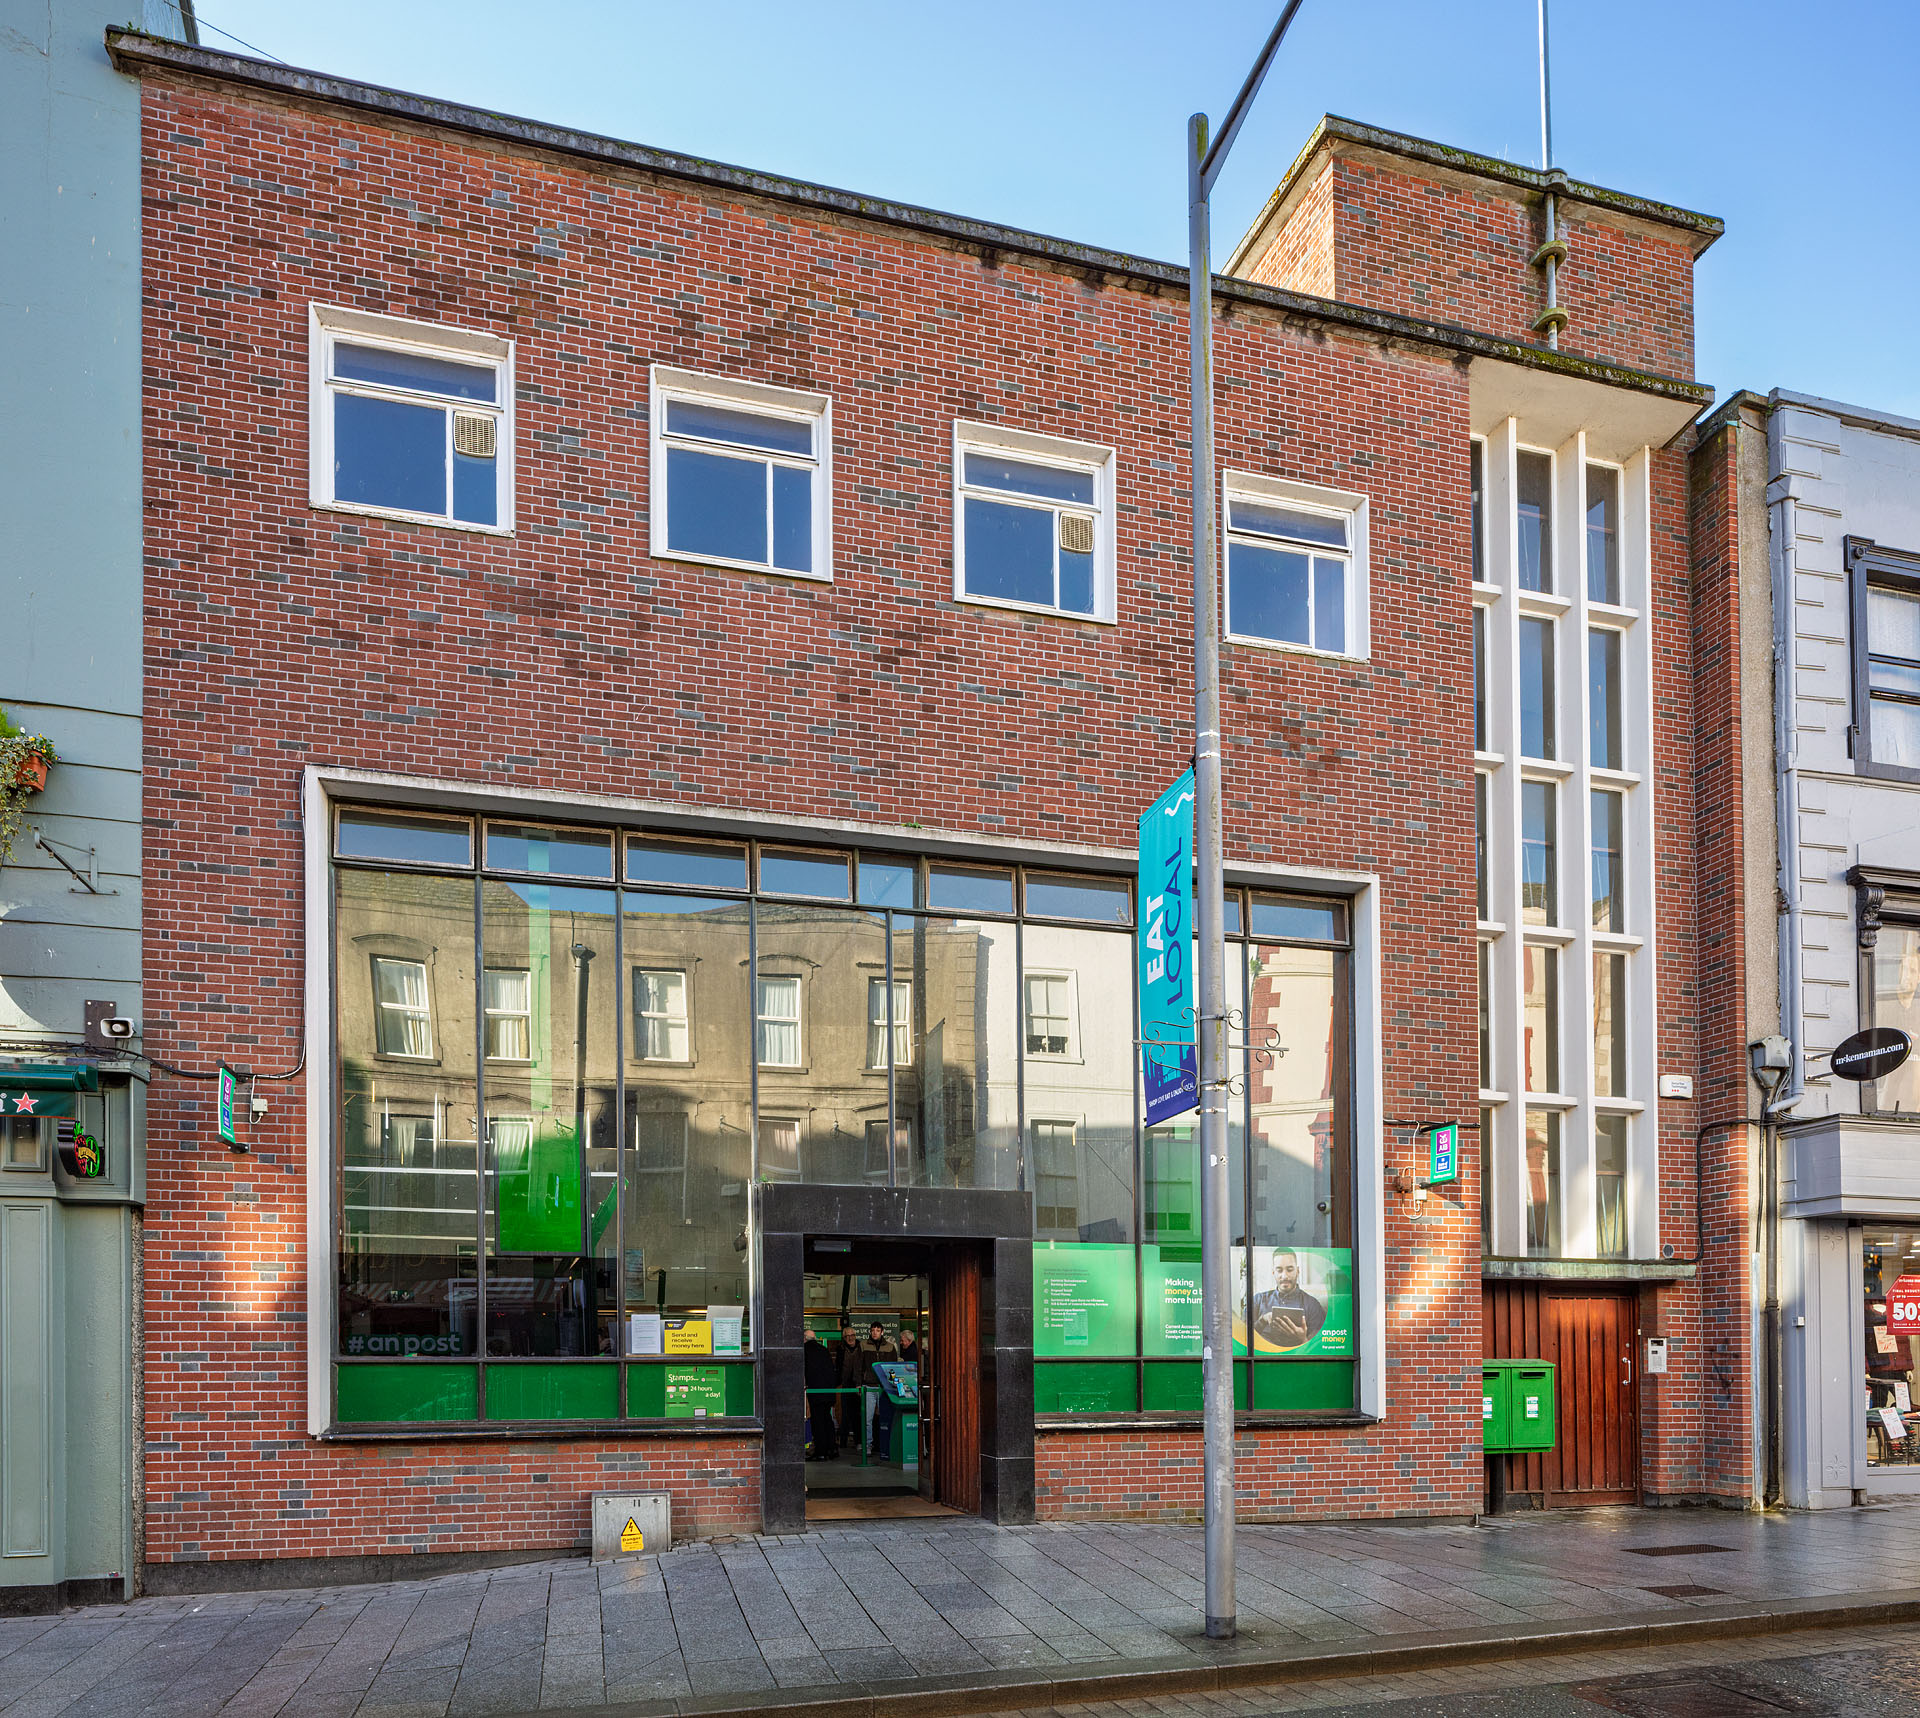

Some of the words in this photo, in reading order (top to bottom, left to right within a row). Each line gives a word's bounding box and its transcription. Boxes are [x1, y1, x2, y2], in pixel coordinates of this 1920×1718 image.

[1165, 836, 1182, 1005] LOCAL
[1147, 894, 1164, 984] EAT
[1438, 1144, 1448, 1152] AIB
[1165, 1278, 1194, 1288] Making
[1164, 1288, 1192, 1296] money
